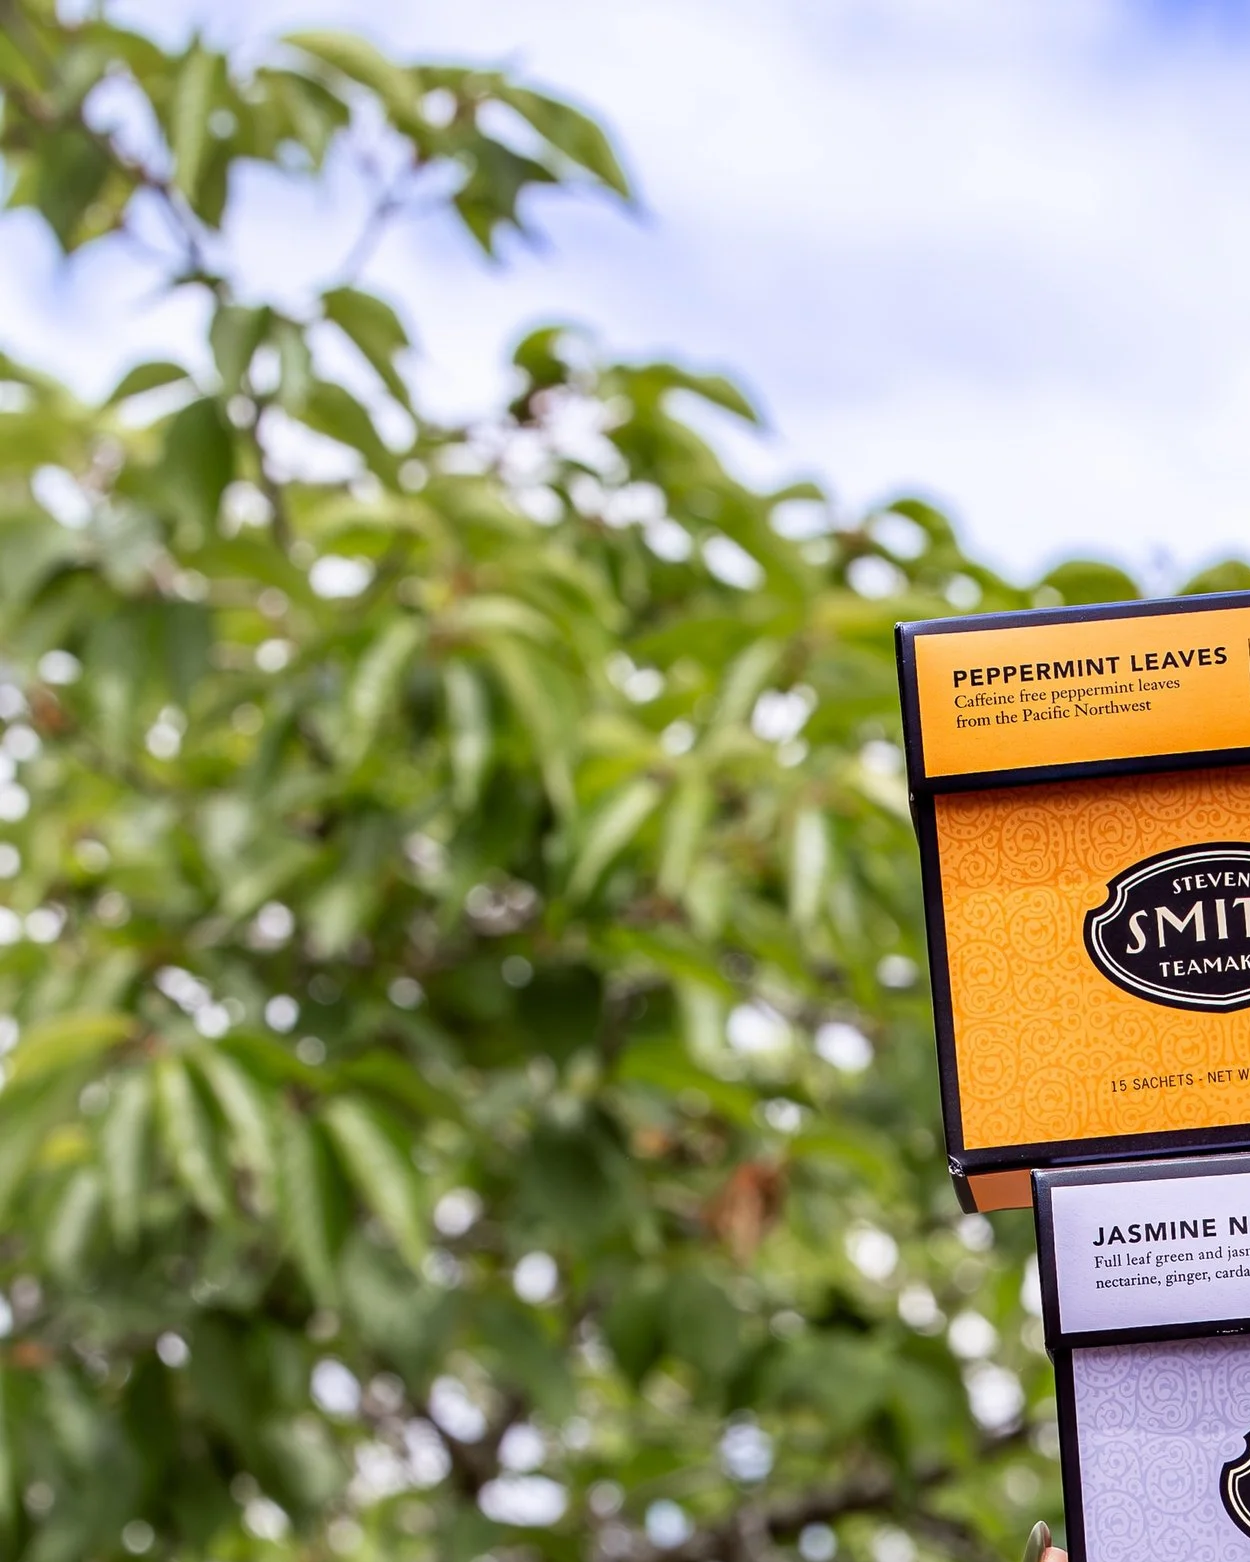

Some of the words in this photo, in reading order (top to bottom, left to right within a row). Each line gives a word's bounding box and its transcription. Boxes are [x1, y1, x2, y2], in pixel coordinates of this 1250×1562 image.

[954, 657, 1119, 688] PEPPERMINT
[1131, 647, 1227, 672] LEAVES
[955, 693, 1014, 708] Caffeine
[1020, 690, 1046, 702] free
[1052, 684, 1133, 703] peppermint
[1139, 679, 1179, 691] leaves
[957, 715, 990, 728] from
[996, 711, 1017, 724] the
[1023, 706, 1069, 722] Pacific
[1075, 701, 1151, 717] Northwest
[1173, 872, 1249, 894] STEVEN
[1112, 1080, 1127, 1092] 15
[1133, 1074, 1193, 1090] SACHETS
[1208, 1070, 1232, 1083] NET
[1093, 1219, 1216, 1246] JASMINE
[1095, 1254, 1121, 1268] Full
[1127, 1252, 1151, 1265] leaf
[1156, 1253, 1193, 1267] green
[1199, 1246, 1222, 1260] and
[1095, 1271, 1162, 1289] nectarine,
[1165, 1268, 1212, 1286] ginger,
